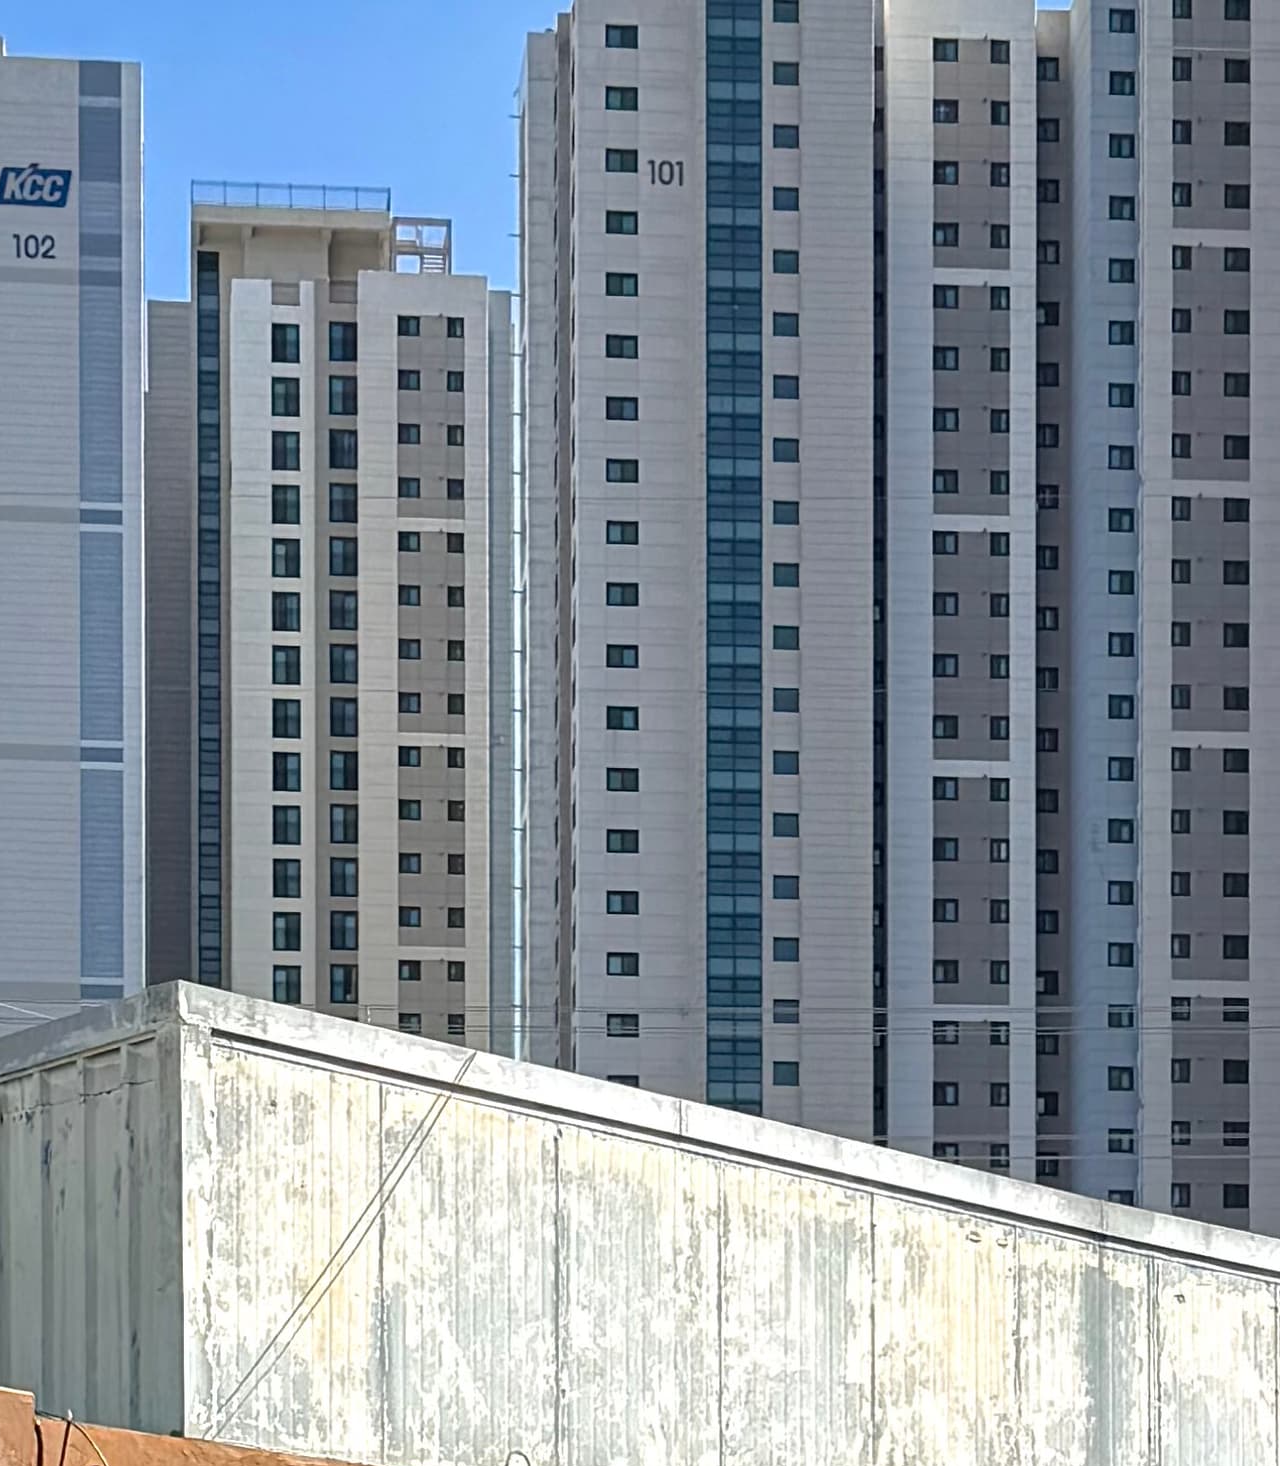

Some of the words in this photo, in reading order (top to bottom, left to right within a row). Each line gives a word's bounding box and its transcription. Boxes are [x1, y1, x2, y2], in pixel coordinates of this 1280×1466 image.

[3, 167, 64, 202] KCC
[648, 160, 683, 186] 101
[13, 233, 56, 259] 102
